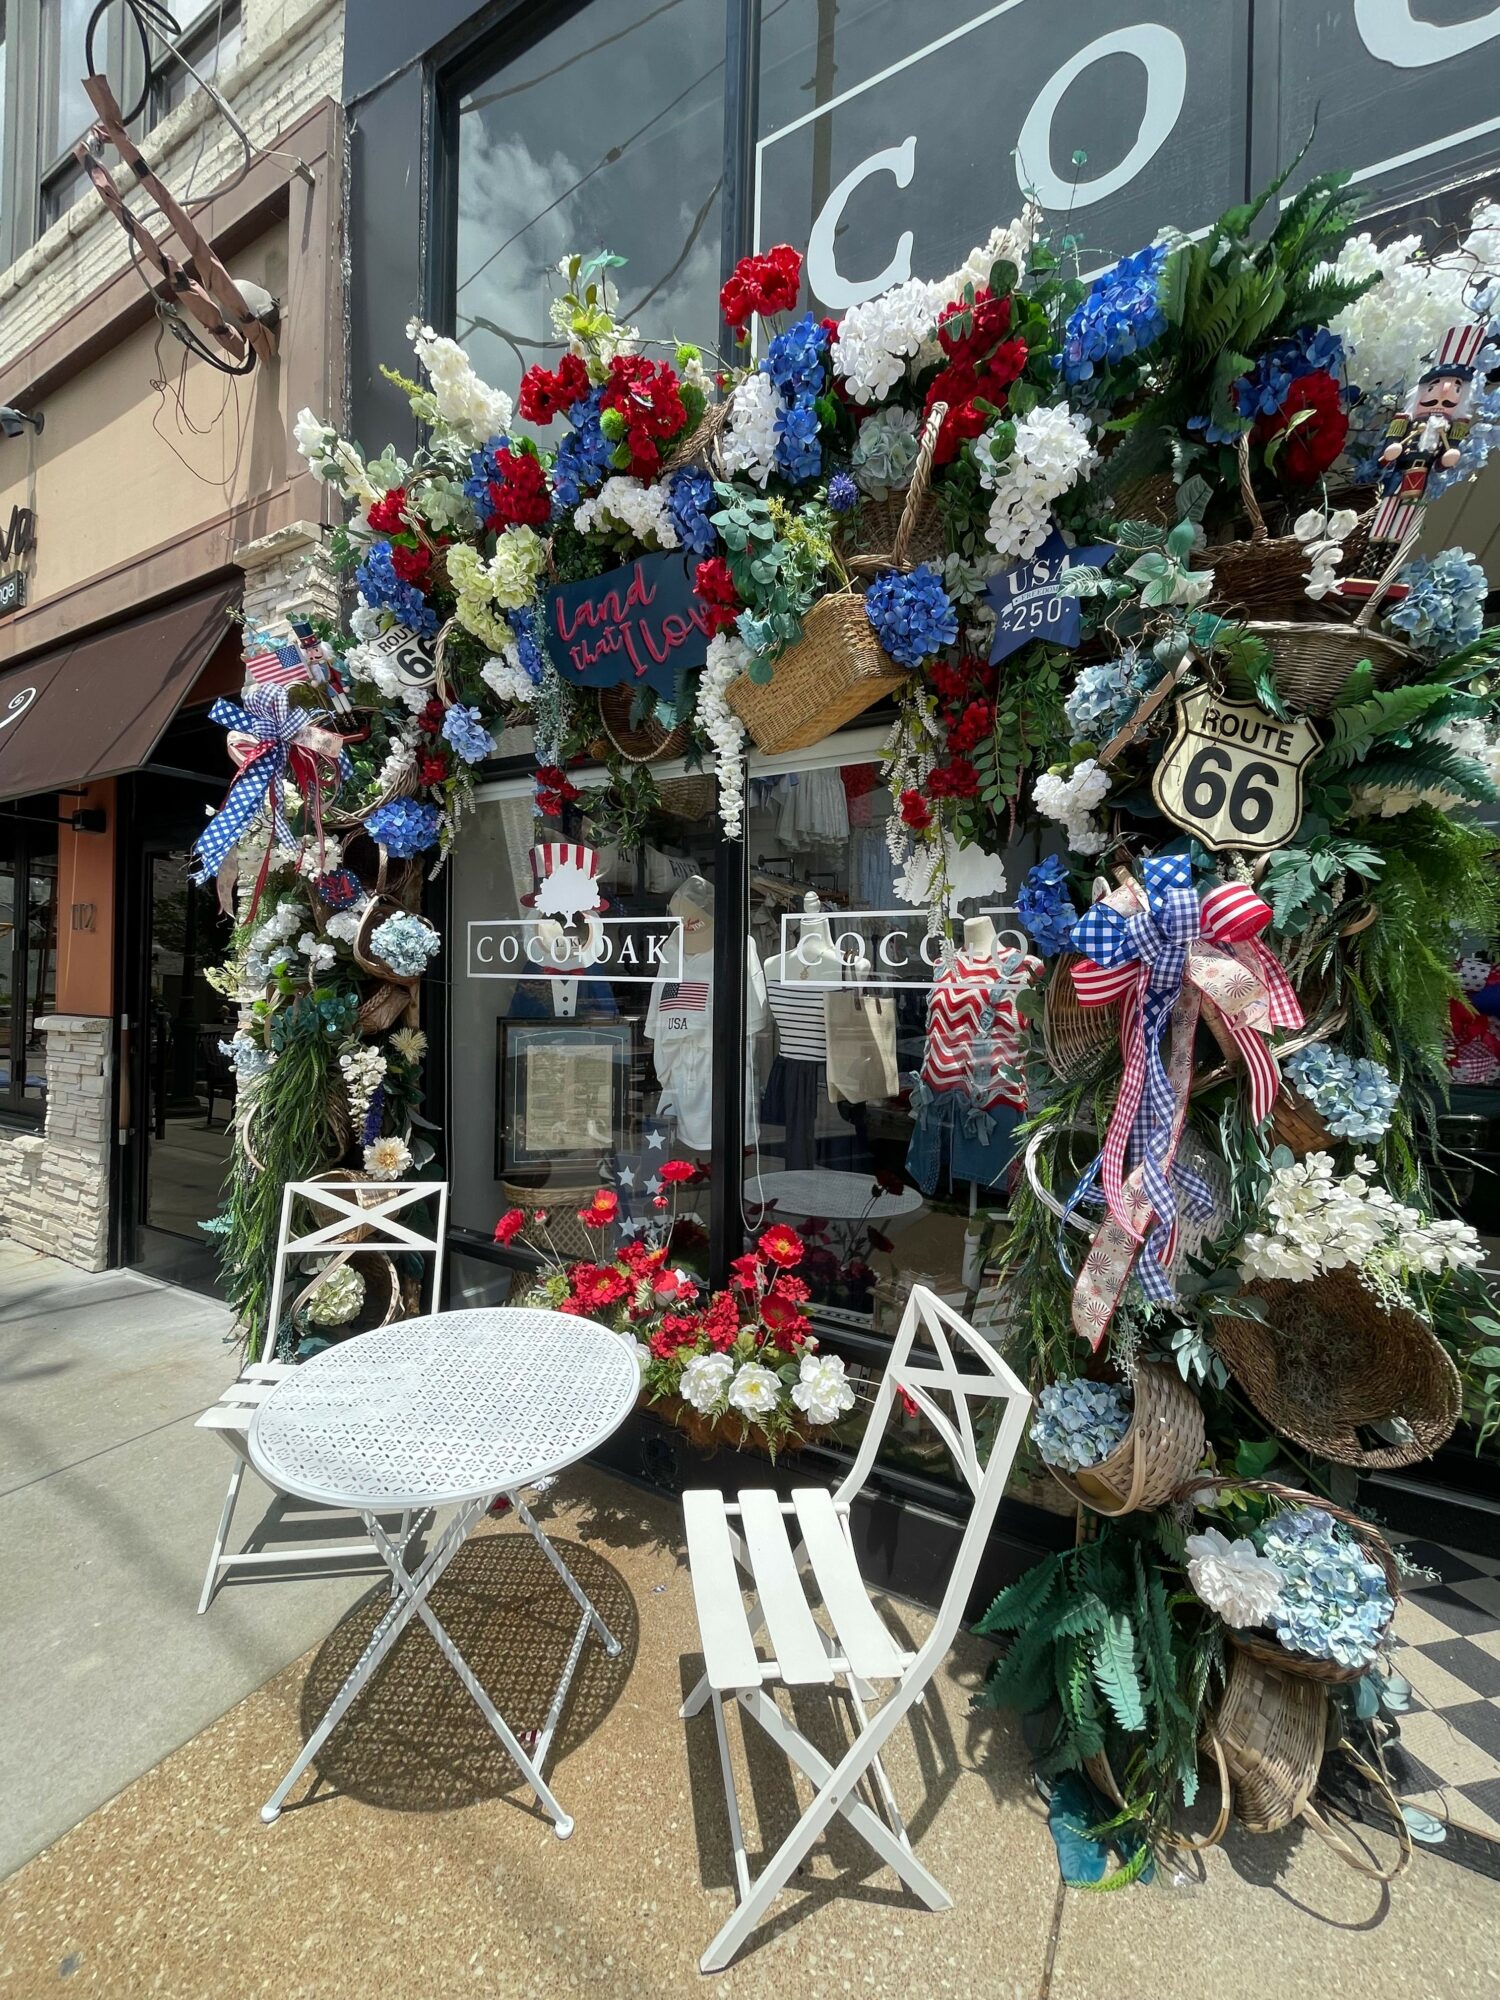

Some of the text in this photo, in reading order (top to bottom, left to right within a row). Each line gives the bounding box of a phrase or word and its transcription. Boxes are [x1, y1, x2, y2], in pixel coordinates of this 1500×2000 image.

[1007, 554, 1070, 595] USA
[556, 563, 657, 641] land
[1012, 597, 1062, 632] 250
[377, 626, 415, 653] ROUT
[569, 603, 712, 677] that I lov
[1201, 706, 1294, 756] ROUTE
[1183, 746, 1279, 835] 66
[668, 1017, 688, 1030] USA
